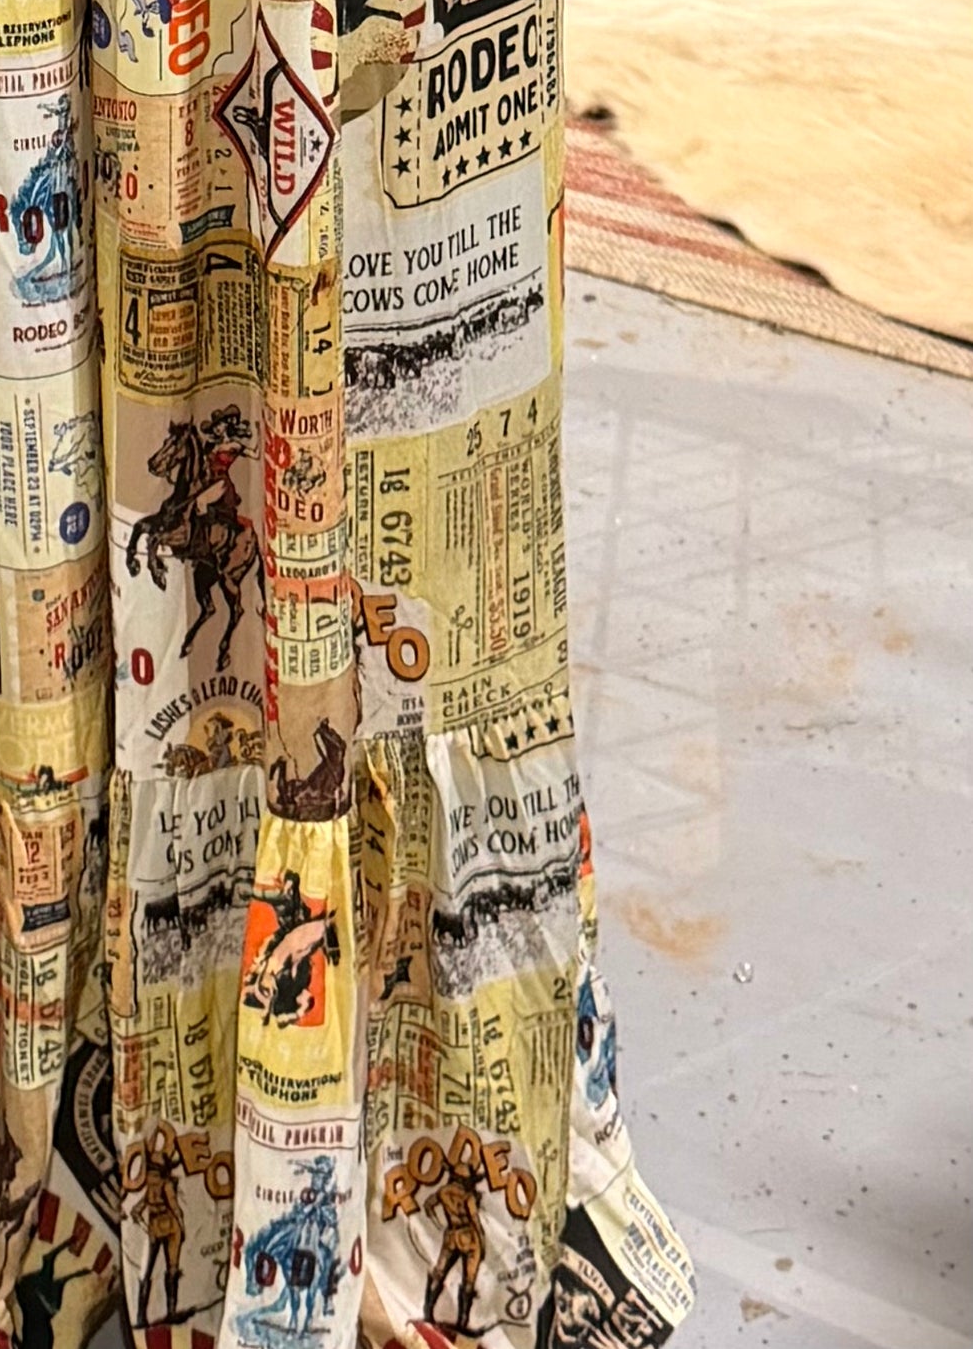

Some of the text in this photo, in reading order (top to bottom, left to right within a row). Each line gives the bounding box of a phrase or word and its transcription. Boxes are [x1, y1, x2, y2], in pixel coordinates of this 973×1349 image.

[426, 14, 540, 119] RODEO
[273, 97, 296, 196] WILD
[432, 79, 539, 162] ADMIT ONE
[403, 204, 522, 274] YOU THE
[467, 242, 519, 285] HOME
[13, 319, 68, 344] RODEO
[125, 297, 142, 346] 4
[23, 409, 40, 490] SEPTEMBER 23
[466, 397, 538, 458] 25 7 4
[0, 421, 18, 528] YOUR PLACE HERE
[380, 510, 413, 588] 6743
[550, 542, 568, 620] LEAGUE
[511, 572, 531, 640] 1919
[200, 676, 237, 701] LEAD
[442, 682, 512, 719] CHECK
[443, 675, 492, 704] RAIN
[381, 1123, 538, 1222] RODEO
